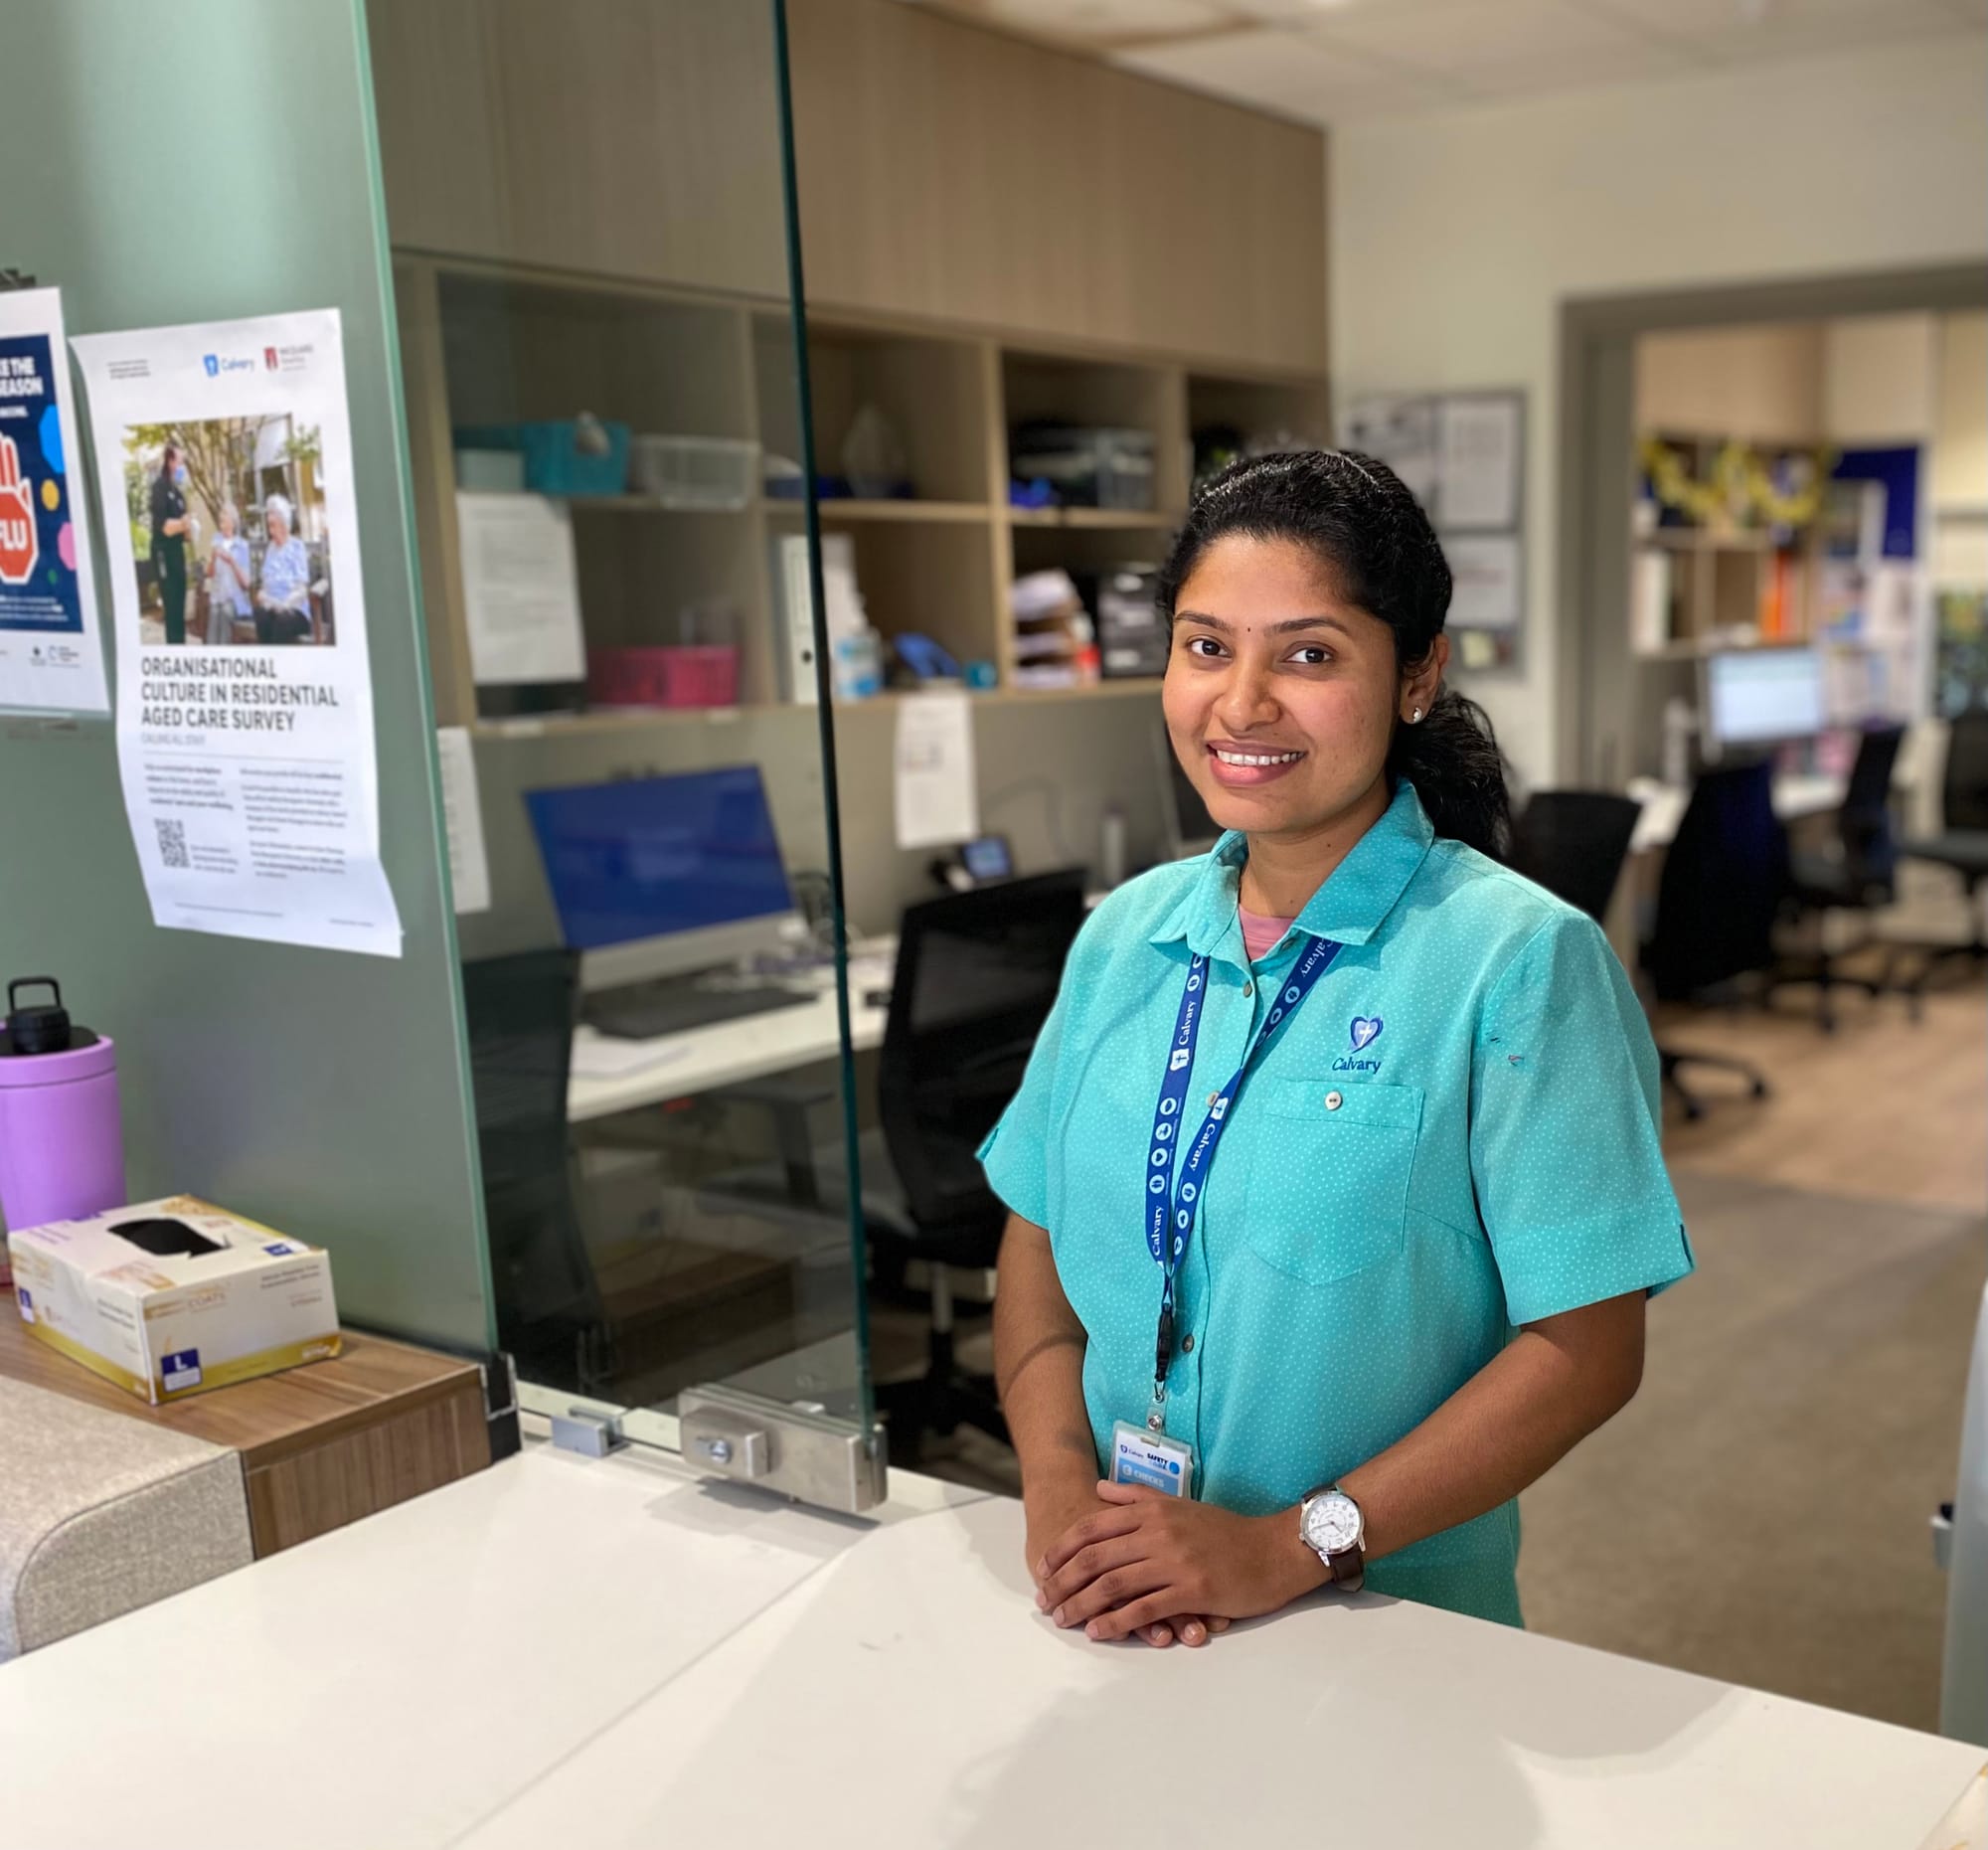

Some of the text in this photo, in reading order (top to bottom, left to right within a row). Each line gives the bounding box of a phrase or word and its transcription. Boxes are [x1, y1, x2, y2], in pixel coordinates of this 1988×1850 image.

[10, 356, 35, 376] THE
[0, 376, 44, 397] EASON
[141, 657, 277, 678] ORGANISATIONAL
[141, 682, 339, 707] CULTURE IN RESIDENTIAL
[141, 707, 295, 731] AGED CARE SURVEY
[1179, 1000, 1196, 1045] Calvary
[1332, 1057, 1382, 1075] Calvary
[1188, 1122, 1216, 1171] Calvary
[1151, 1205, 1165, 1256] Calvary
[174, 1354, 188, 1371] L
[1146, 1452, 1169, 1464] SAFETY
